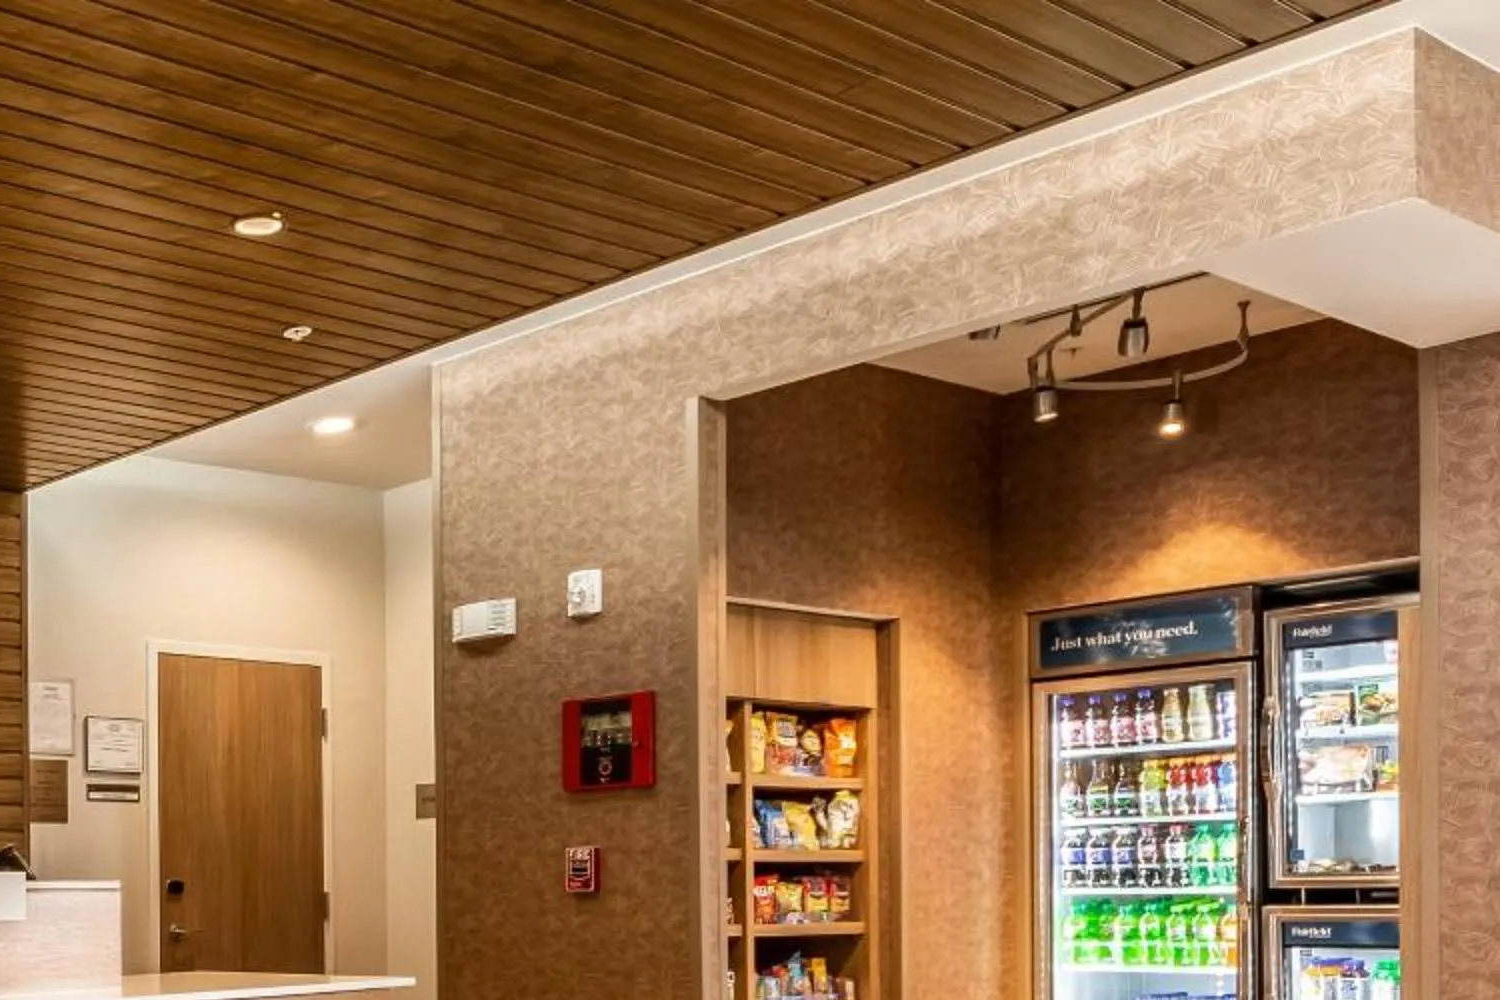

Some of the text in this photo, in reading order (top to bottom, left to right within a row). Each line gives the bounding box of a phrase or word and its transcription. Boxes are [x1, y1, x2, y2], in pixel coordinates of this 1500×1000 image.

[1051, 620, 1199, 652] Just what you need.
